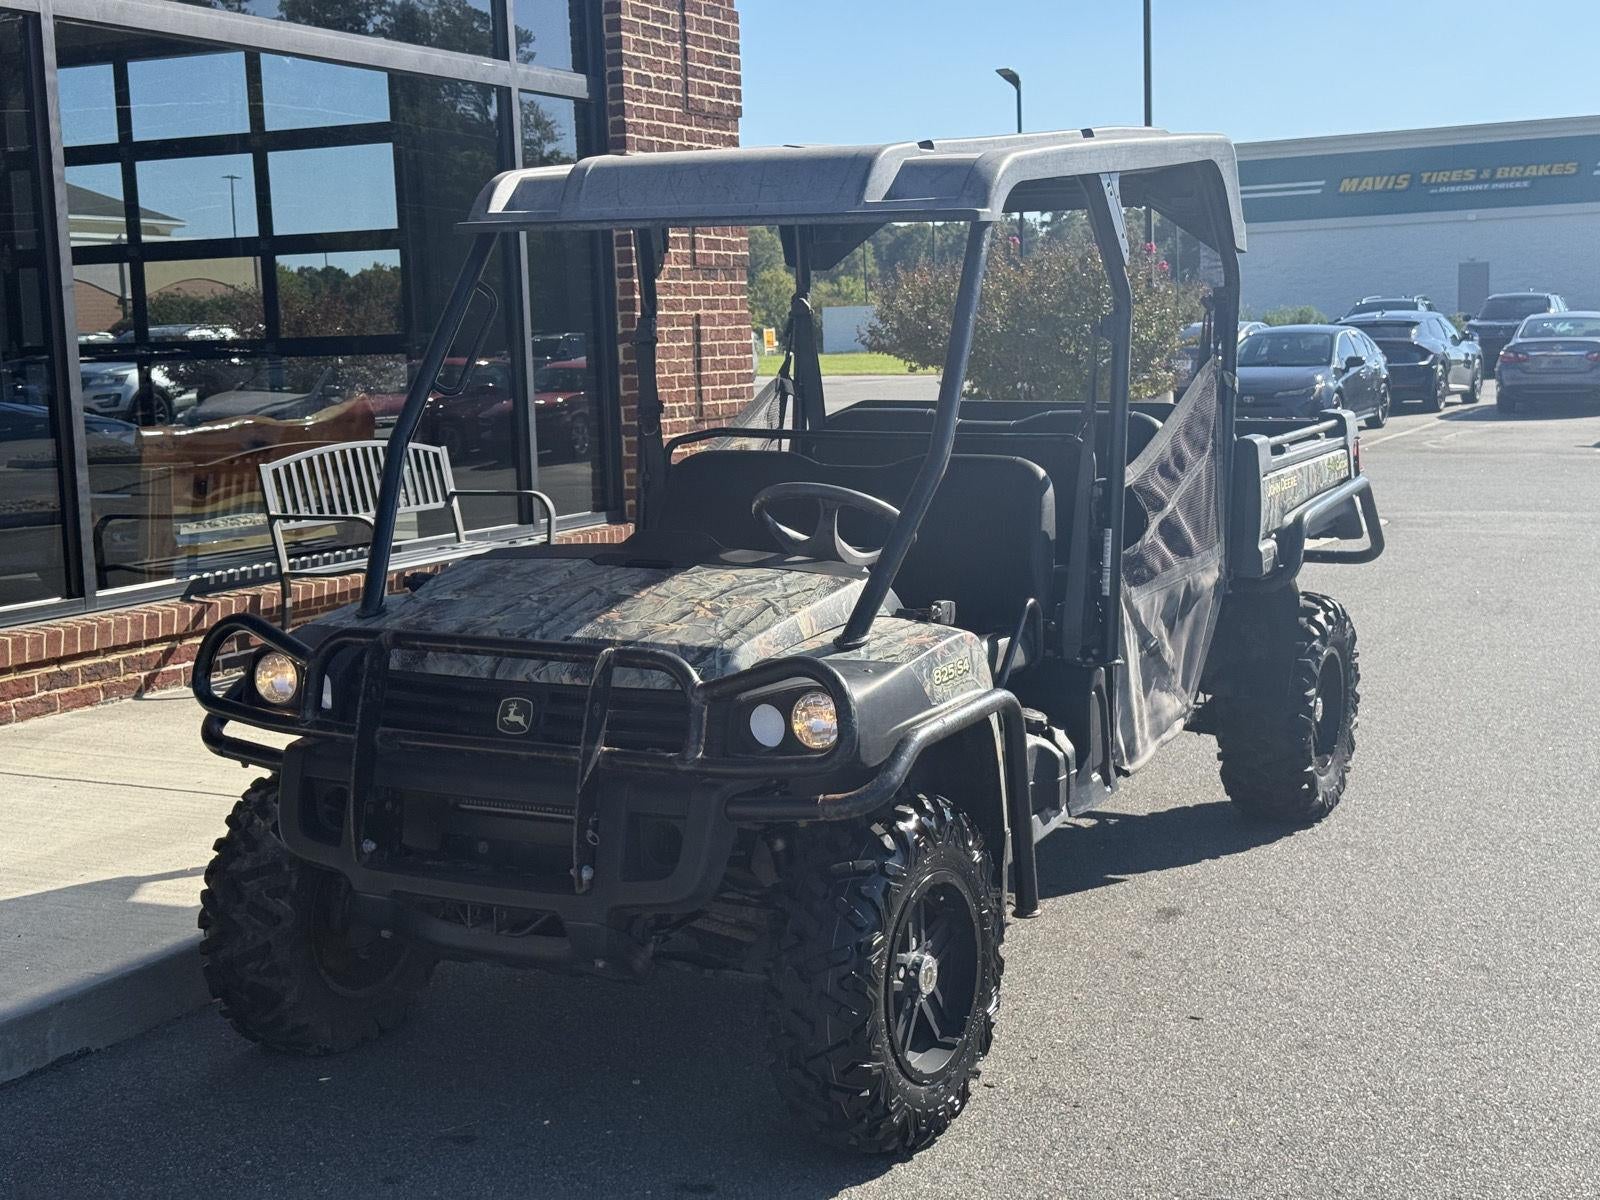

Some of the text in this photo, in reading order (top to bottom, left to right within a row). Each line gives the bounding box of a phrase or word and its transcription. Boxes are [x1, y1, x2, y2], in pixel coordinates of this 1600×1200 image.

[1339, 162, 1578, 192] MAVIS TIRES & BRAKES
[1439, 183, 1489, 192] DISCOUNT
[957, 656, 970, 676] S4
